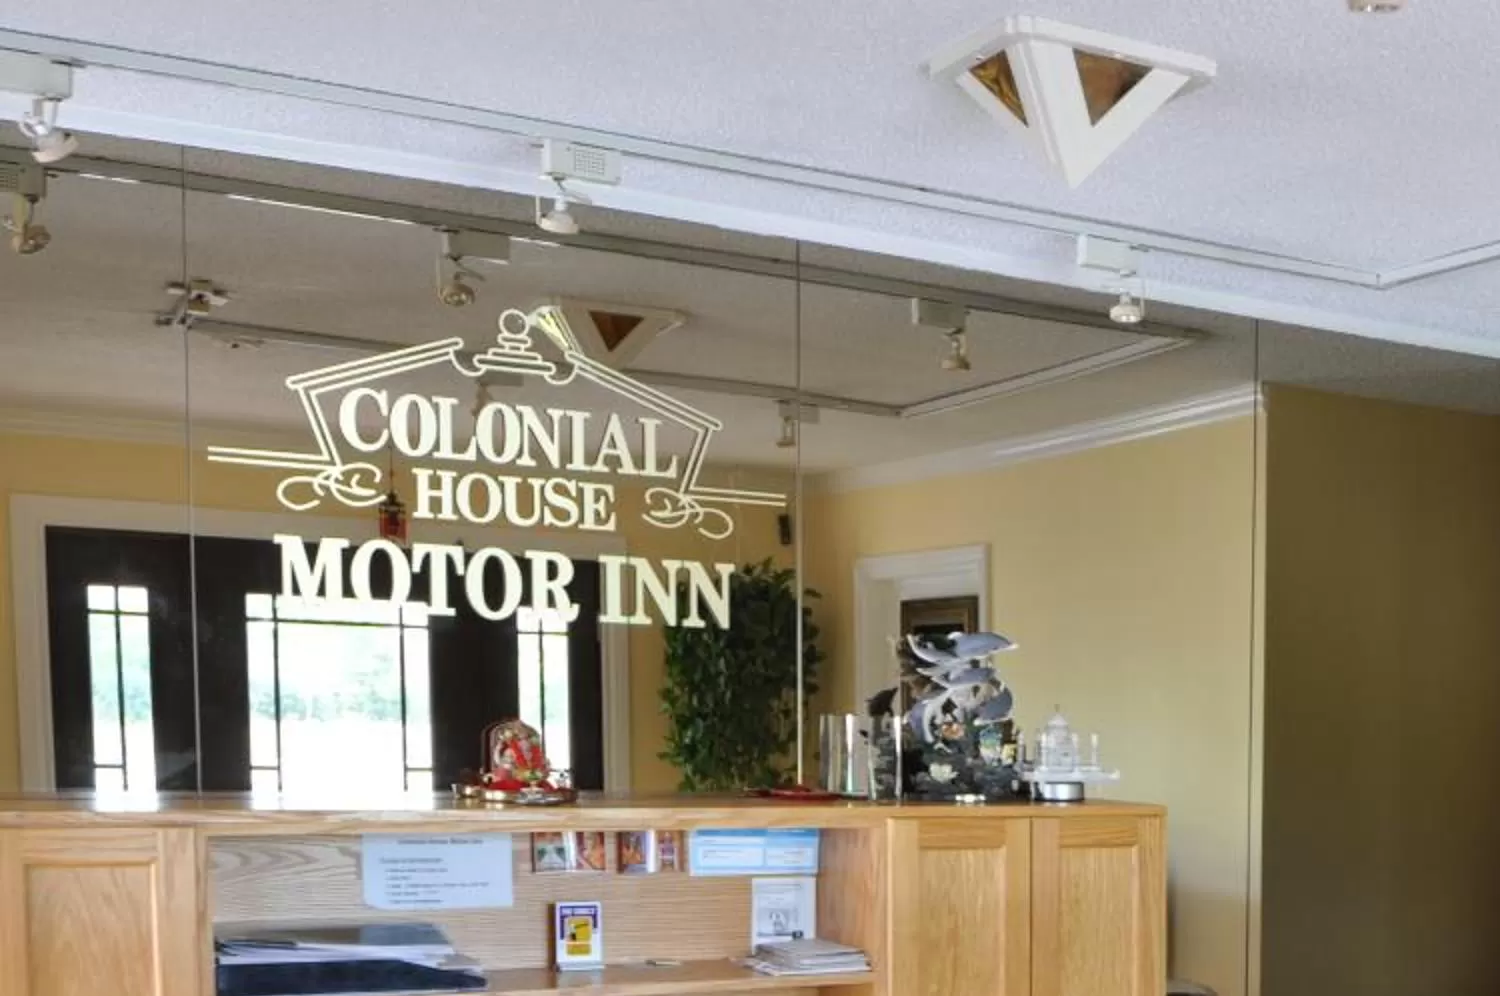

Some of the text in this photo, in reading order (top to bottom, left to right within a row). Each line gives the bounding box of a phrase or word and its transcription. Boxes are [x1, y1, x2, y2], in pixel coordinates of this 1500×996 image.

[338, 387, 678, 478] COLONIAL
[411, 468, 617, 531] HOUSE
[273, 535, 735, 631] MOTOR INN
